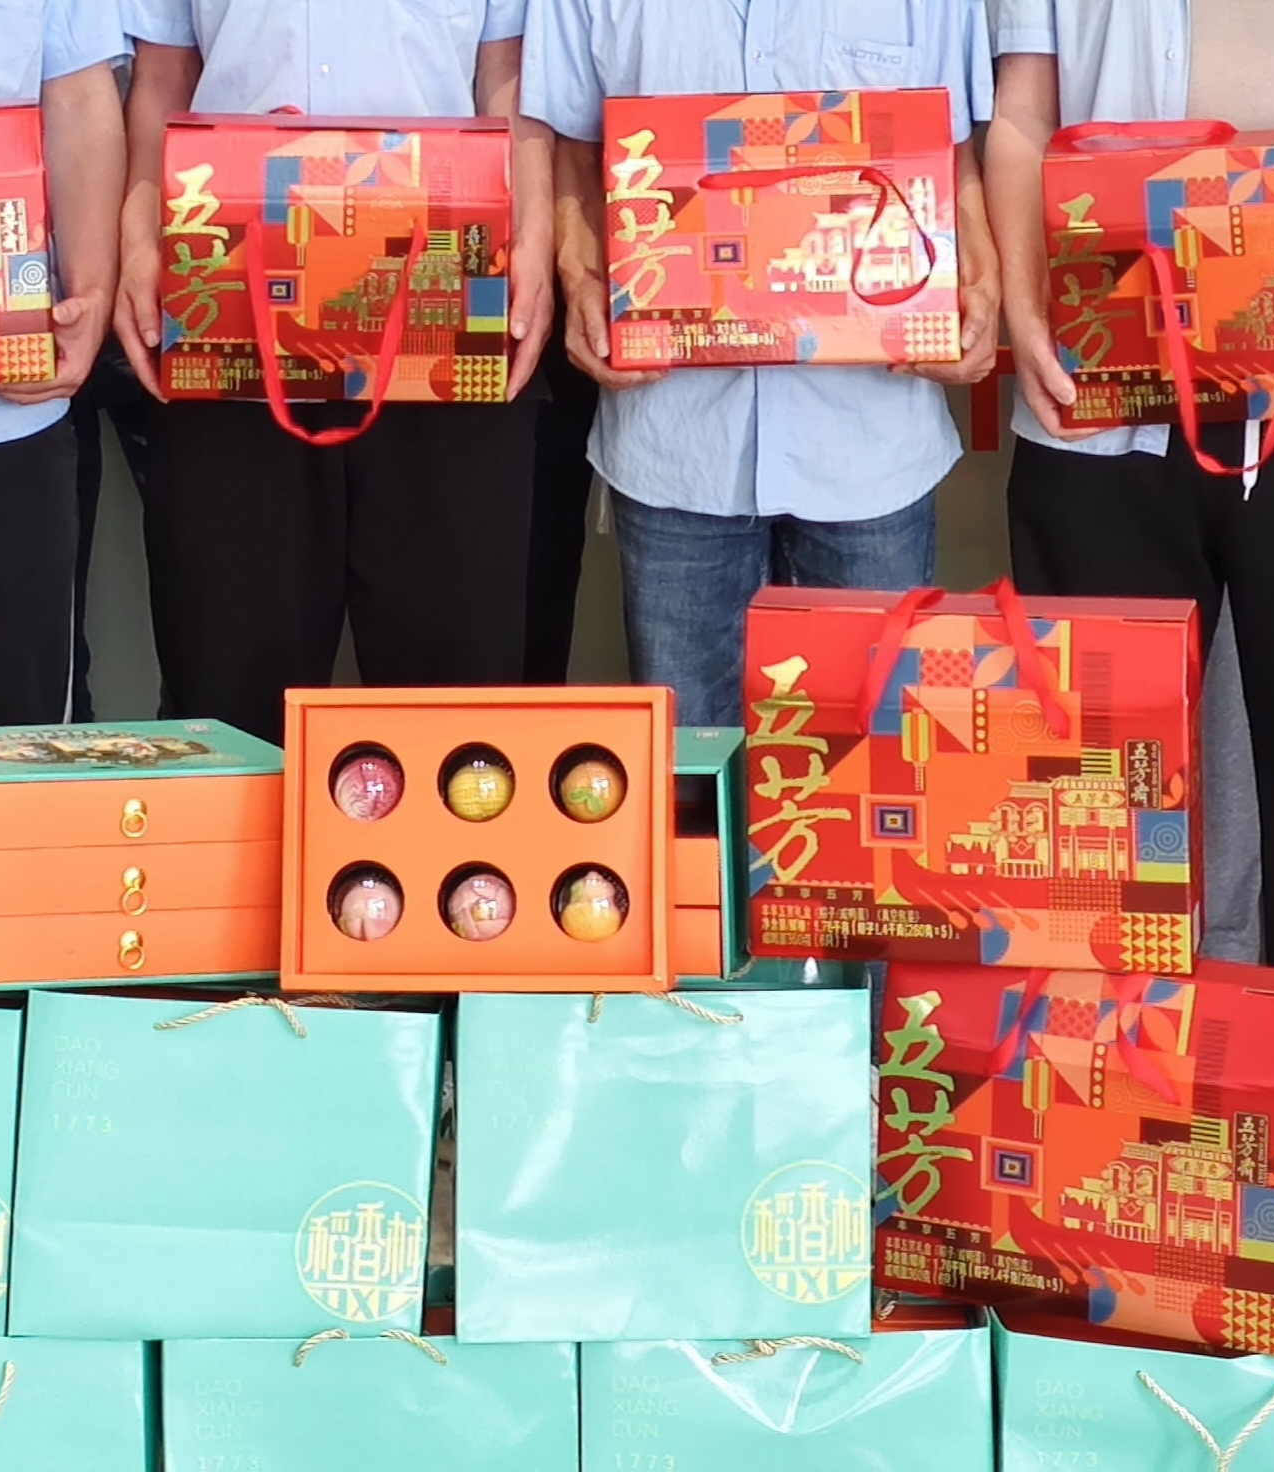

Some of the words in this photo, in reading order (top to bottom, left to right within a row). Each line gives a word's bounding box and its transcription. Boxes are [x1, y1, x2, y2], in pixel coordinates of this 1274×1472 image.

[607, 129, 692, 308] 五芳
[163, 163, 245, 339] 五芳
[1049, 193, 1136, 368] 五芳
[746, 654, 851, 882] 五芳
[53, 1035, 102, 1054] DAO
[53, 1058, 120, 1080] XIANG
[52, 1080, 98, 1100] CUN
[876, 990, 972, 1215] 五芳
[53, 1113, 113, 1133] 1773
[750, 1180, 869, 1263] 稻香村
[303, 1200, 424, 1285] 稻香村
[611, 1375, 660, 1394] DAO
[1035, 1378, 1084, 1400] DAO
[612, 1398, 679, 1417] XIANG
[1034, 1401, 1104, 1422] XIANG
[611, 1419, 658, 1439] CUN
[1033, 1420, 1083, 1439] CUN
[615, 1452, 676, 1471] 1773
[1036, 1450, 1099, 1469] 1773
